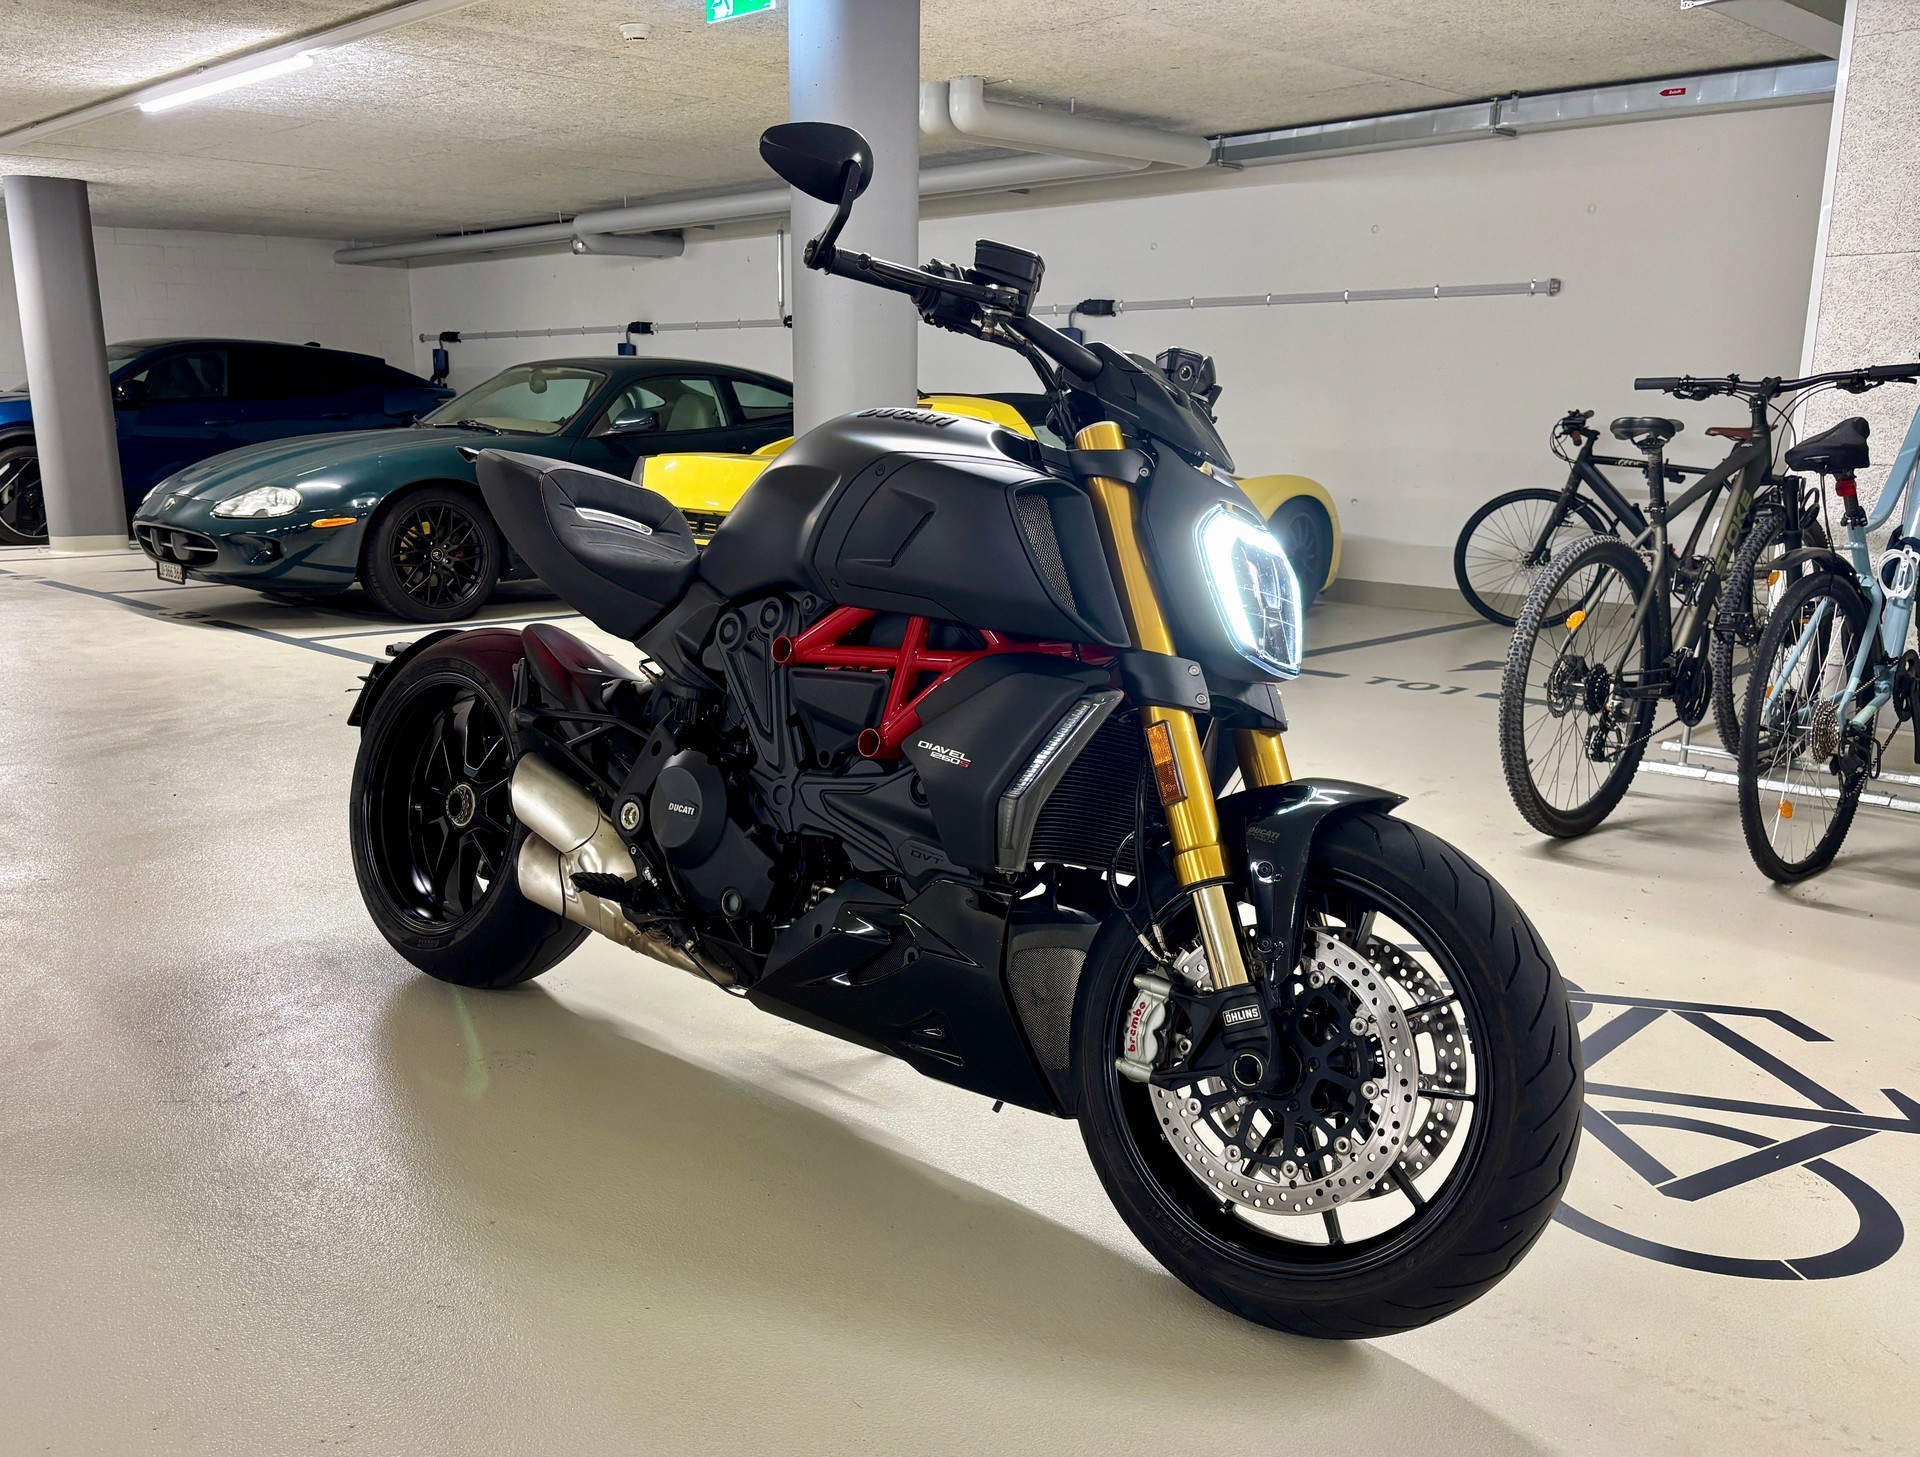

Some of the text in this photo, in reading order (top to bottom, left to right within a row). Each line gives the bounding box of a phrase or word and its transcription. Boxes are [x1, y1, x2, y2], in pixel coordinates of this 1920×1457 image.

[857, 408, 960, 427] DUCATI
[917, 740, 971, 763] DIAVEL
[668, 802, 695, 816] DUCATI
[1247, 826, 1280, 840] DUCATI
[1225, 1007, 1260, 1023] ÖHLINS
[1128, 1001, 1146, 1053] brembo
